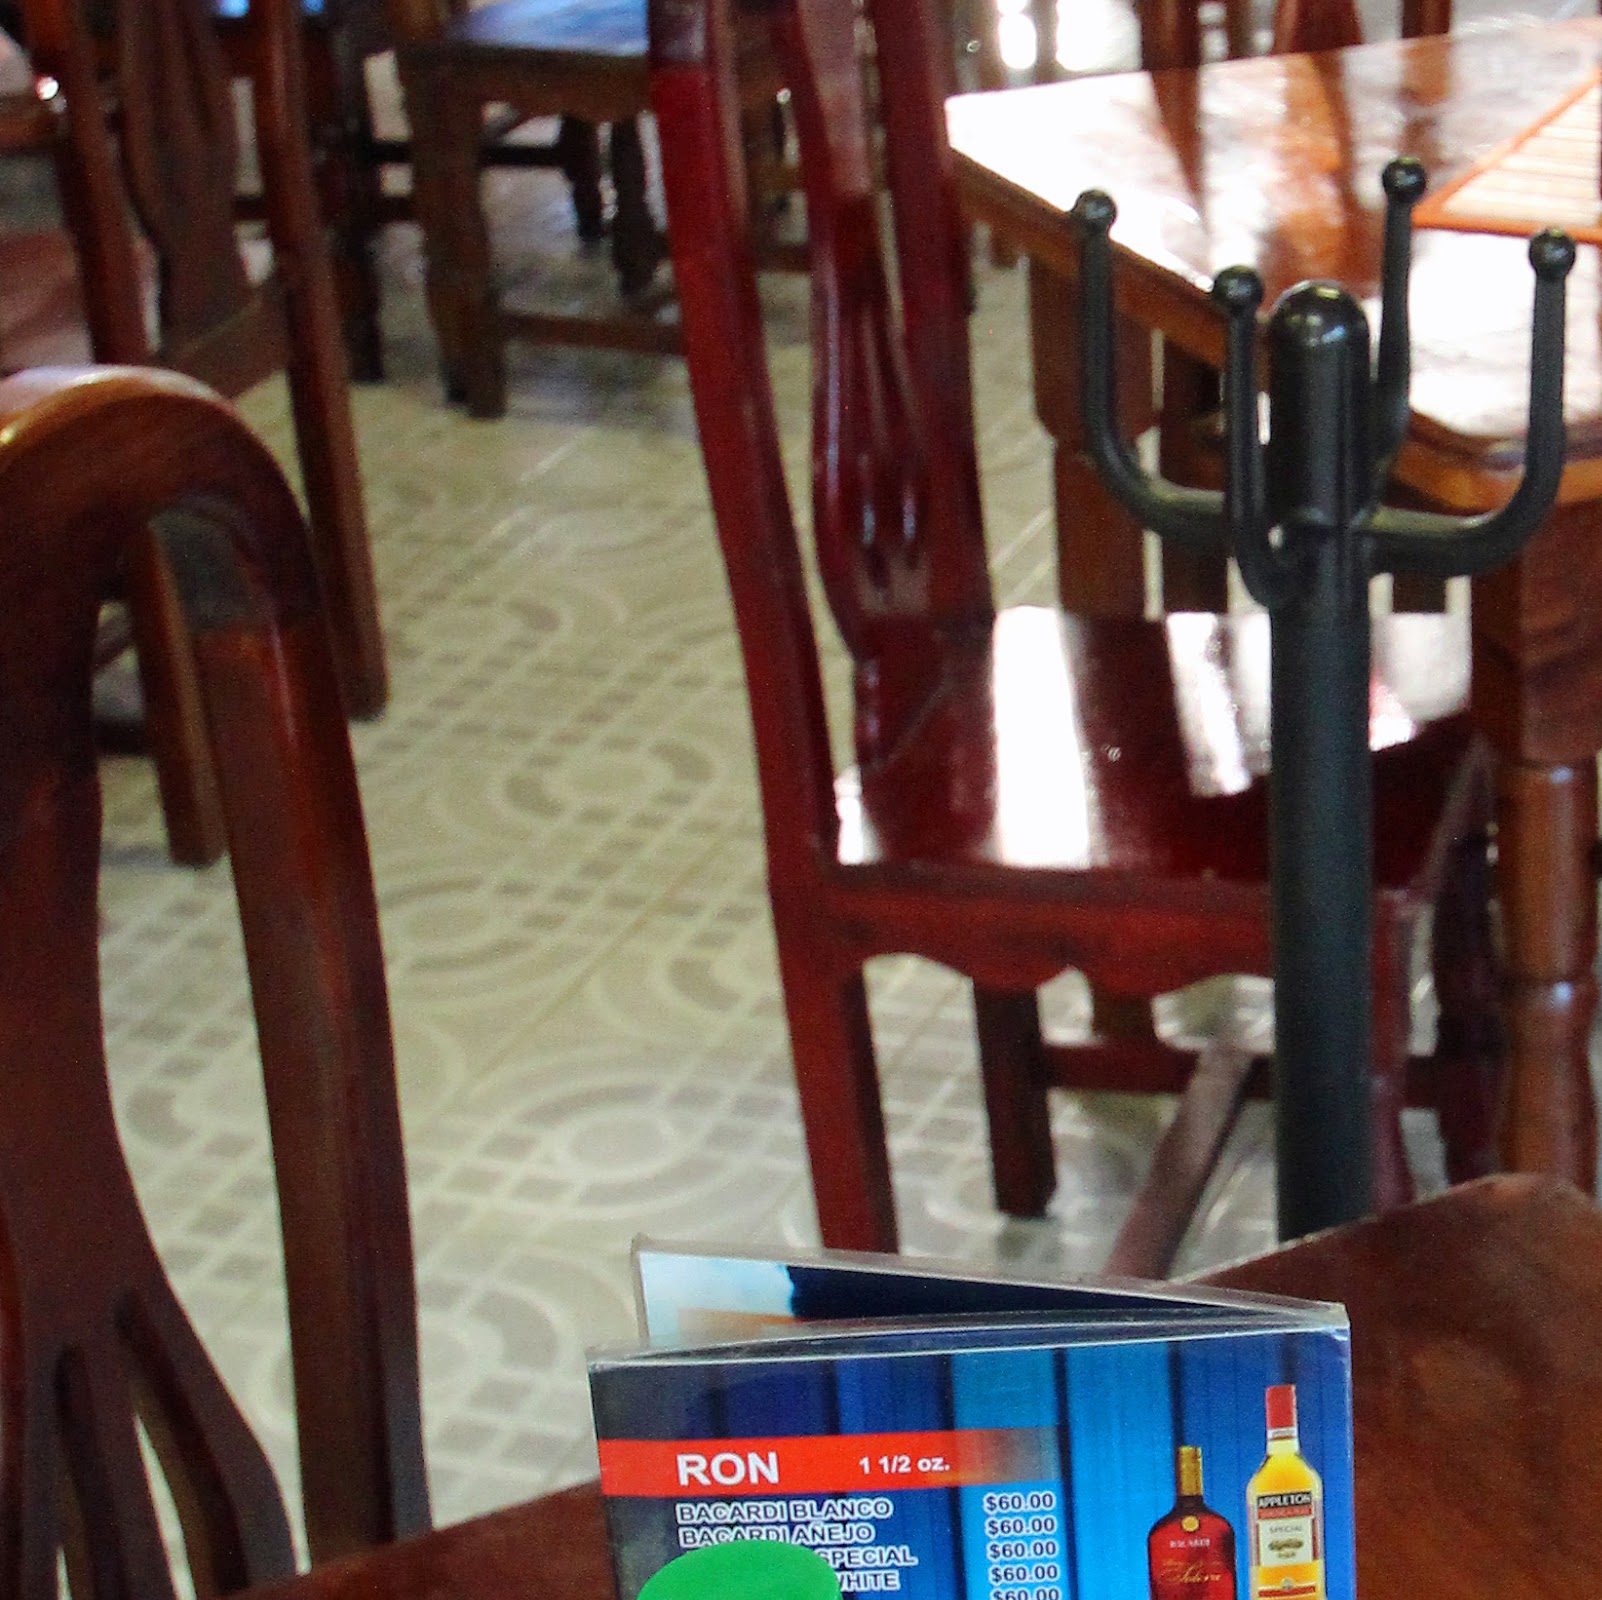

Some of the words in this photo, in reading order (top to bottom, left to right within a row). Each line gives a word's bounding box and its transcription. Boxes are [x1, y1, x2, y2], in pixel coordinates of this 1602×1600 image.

[676, 1451, 780, 1486] RON
[859, 1456, 870, 1474] 1
[879, 1455, 911, 1474] 1/2
[917, 1456, 950, 1473] oz.
[676, 1501, 787, 1524] BACARDI
[789, 1497, 893, 1522] BLANCO
[983, 1491, 1056, 1514] $60.00
[678, 1526, 788, 1549] BACARDI
[788, 1520, 877, 1545] AÑEJO
[984, 1516, 1057, 1537] $60.00
[986, 1540, 1058, 1561] $60.00
[989, 1564, 1060, 1584] $60.00
